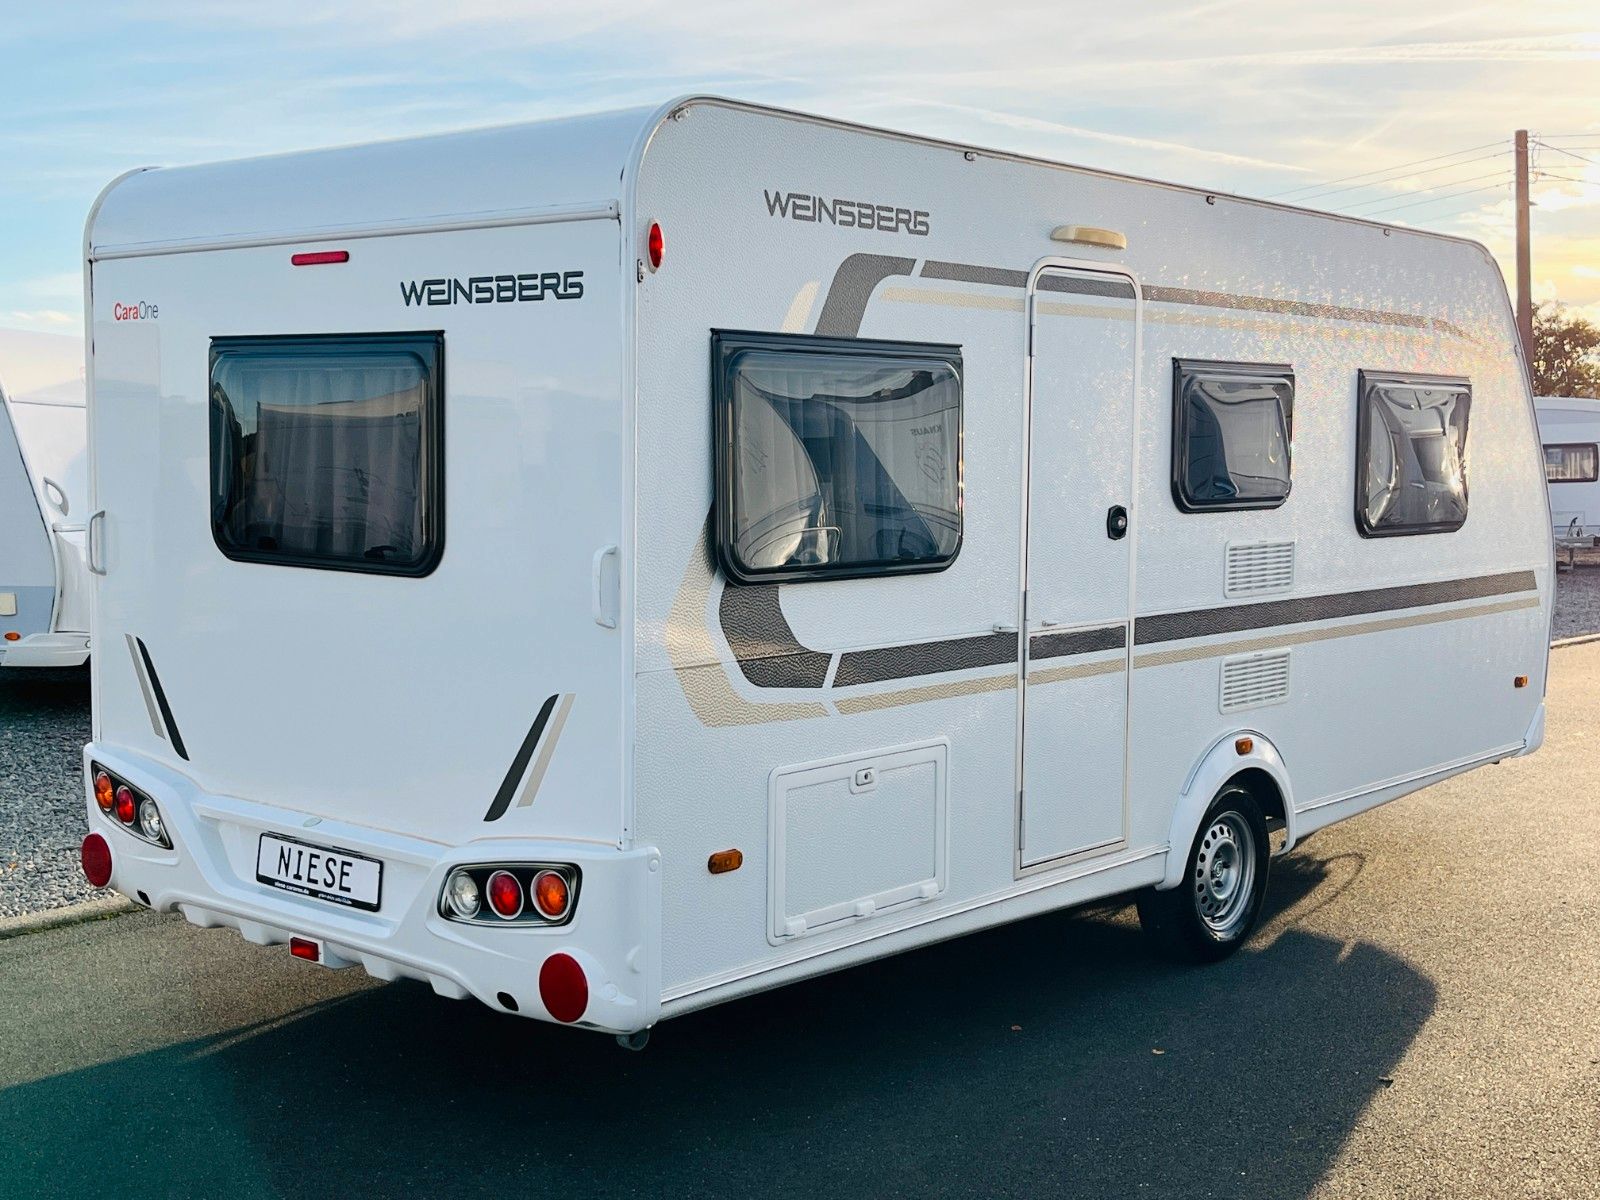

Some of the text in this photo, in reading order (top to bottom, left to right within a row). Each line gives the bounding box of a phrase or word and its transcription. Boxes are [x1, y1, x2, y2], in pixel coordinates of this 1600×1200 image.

[764, 189, 930, 236] WEINSBERG
[400, 270, 584, 307] WEINSBERG
[114, 300, 159, 321] CaraOne
[277, 845, 353, 893] NIESE
